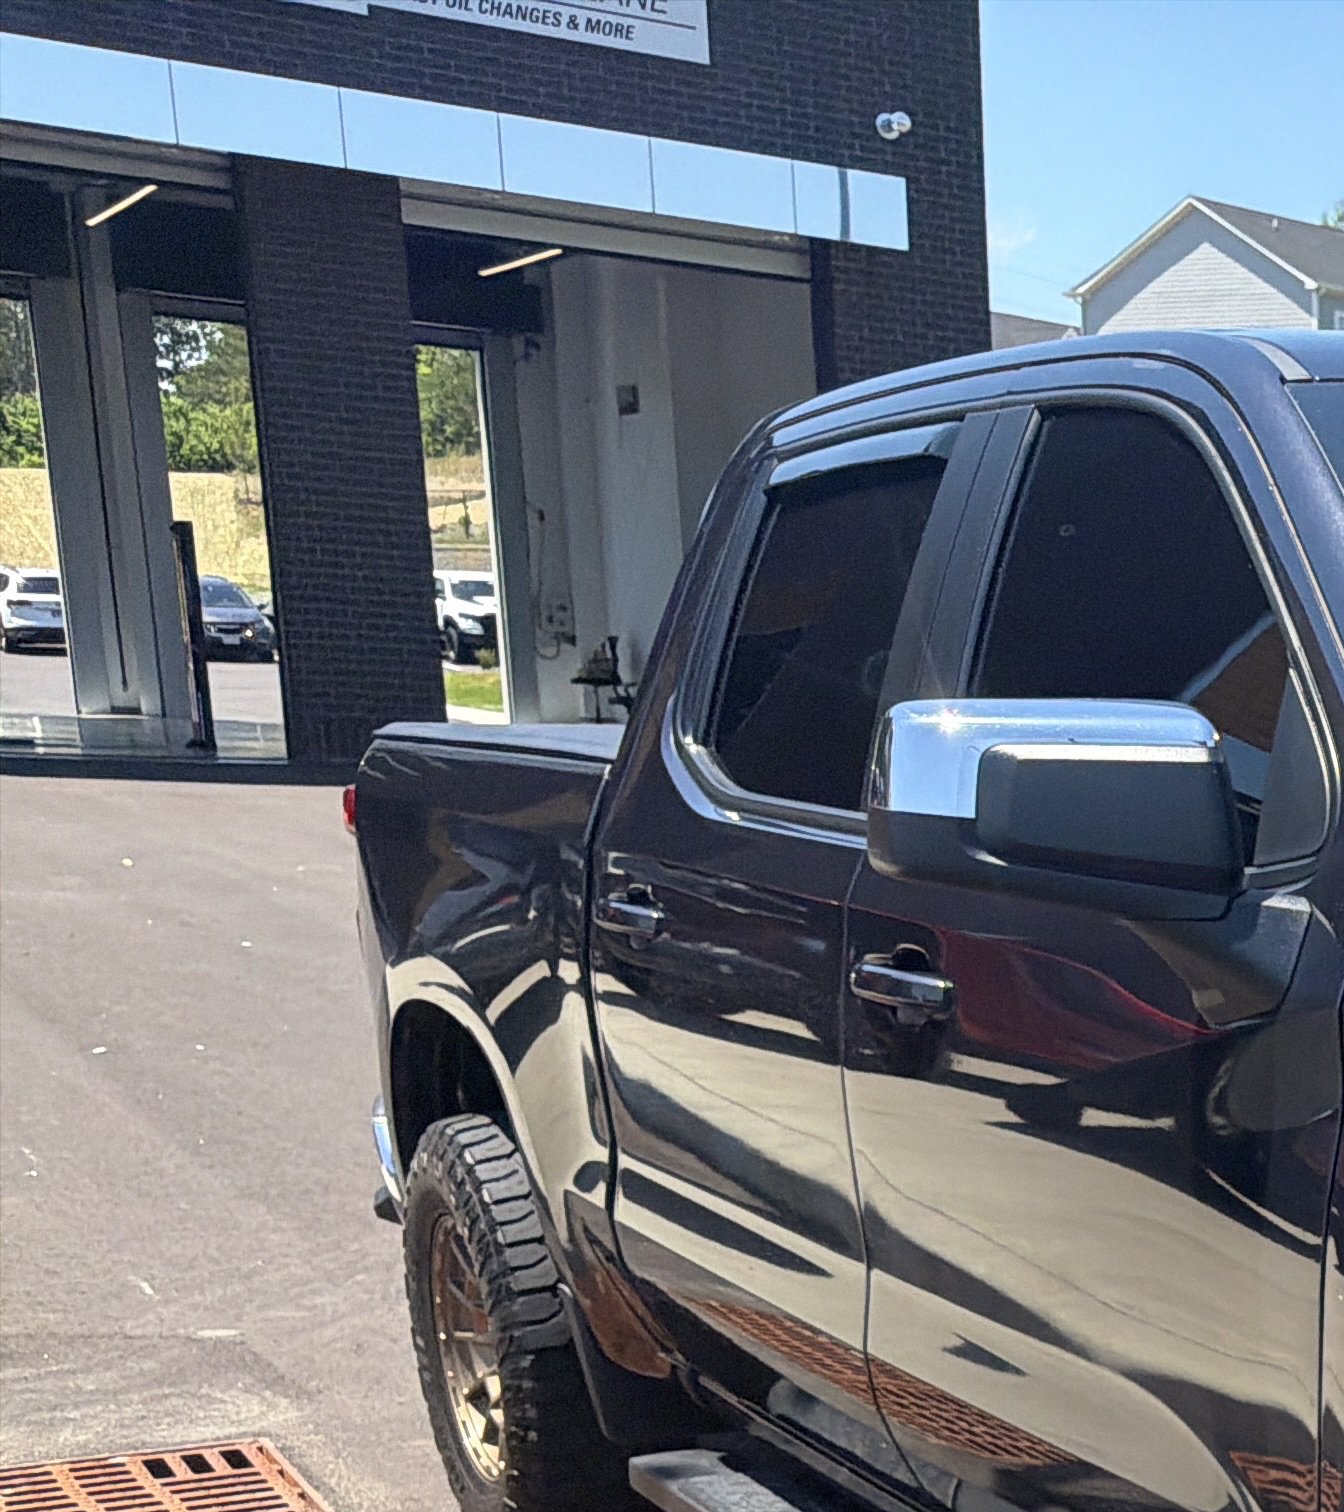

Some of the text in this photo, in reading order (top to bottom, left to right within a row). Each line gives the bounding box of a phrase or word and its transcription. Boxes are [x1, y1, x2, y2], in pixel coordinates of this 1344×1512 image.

[445, 0, 635, 41] OIL CHANGES & MORE
